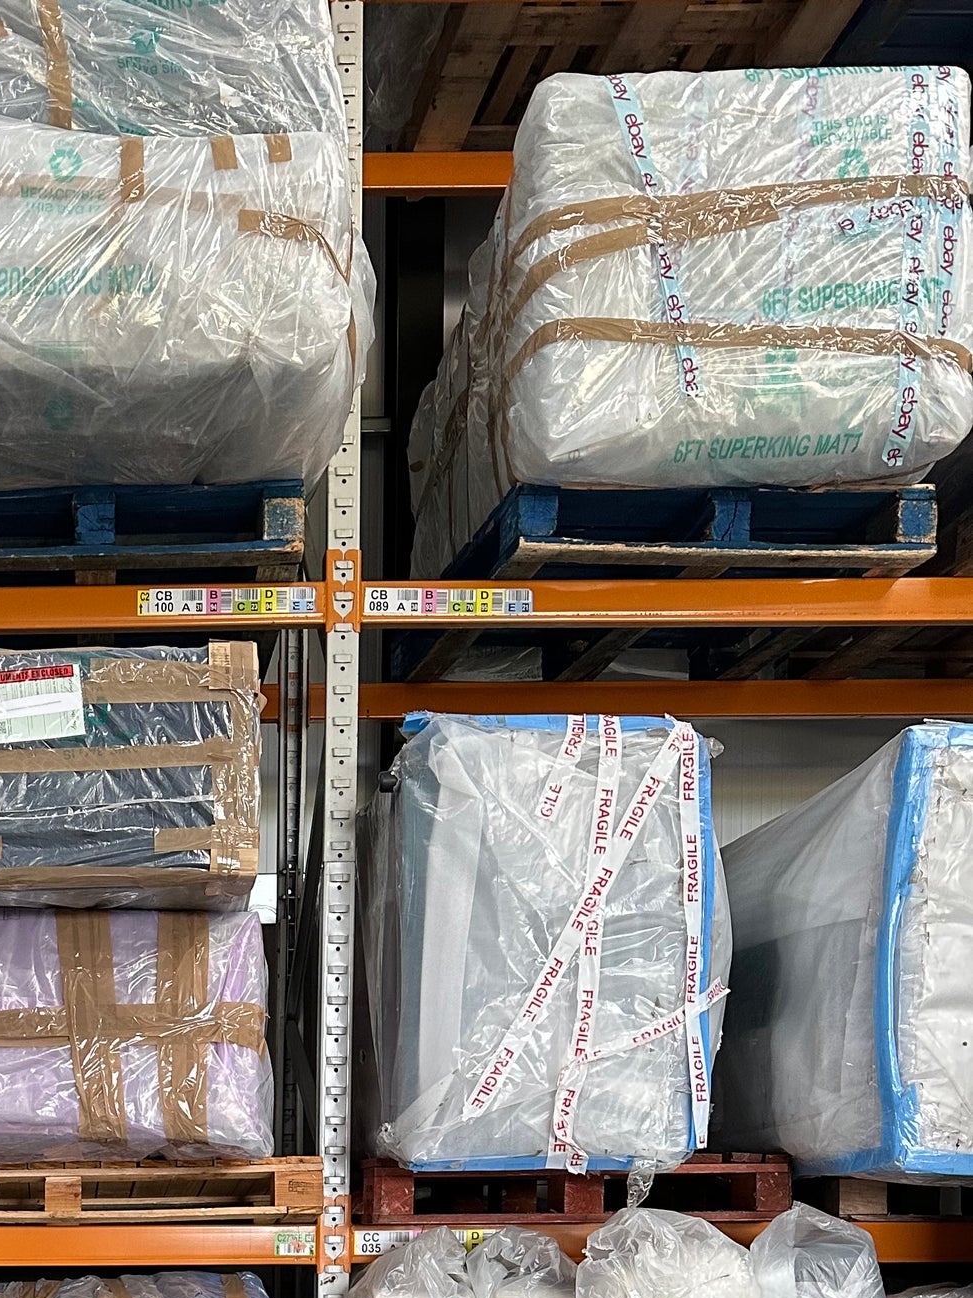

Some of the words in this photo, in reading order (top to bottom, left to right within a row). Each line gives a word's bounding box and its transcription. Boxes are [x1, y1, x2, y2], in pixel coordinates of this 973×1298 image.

[813, 119, 841, 132] THIS
[624, 113, 647, 158] ebay
[940, 226, 958, 276] ebay
[762, 288, 791, 316] 6FT
[798, 280, 901, 312] SUPERKING
[892, 386, 918, 440] ebay
[673, 440, 706, 464] 6FT
[707, 436, 810, 461] SUPERKING
[813, 432, 863, 455] MATT
[156, 591, 172, 601] CB
[210, 591, 218, 599] B
[265, 590, 273, 598] D
[371, 590, 388, 600] CB
[426, 591, 433, 599] B
[481, 591, 489, 600] D
[155, 602, 173, 612] 100
[182, 603, 190, 611] A
[237, 602, 245, 611] C
[293, 602, 300, 610] E
[369, 601, 388, 612] 089
[397, 603, 405, 611] A
[452, 603, 461, 612] C
[509, 603, 516, 611] E
[31, 667, 69, 679] ENCLOSED
[564, 716, 585, 758] FRAGIL
[602, 713, 617, 757] RAGILE
[682, 733, 695, 801] FRAGILE
[540, 783, 562, 818] GILE
[619, 775, 662, 841] FRAGILE
[594, 788, 613, 855] FRAGILE
[687, 834, 699, 902] FRAGILE
[571, 867, 613, 932] FRAGILE
[687, 936, 699, 1003] FRAGILE
[523, 957, 563, 1022] FRAGILE
[574, 989, 594, 1059] FRAGILE
[692, 1036, 707, 1102] FRAGILE
[471, 1046, 514, 1109] FRAGILE
[364, 1233, 379, 1242] CC
[472, 1232, 479, 1240] D
[362, 1243, 381, 1253] 035
